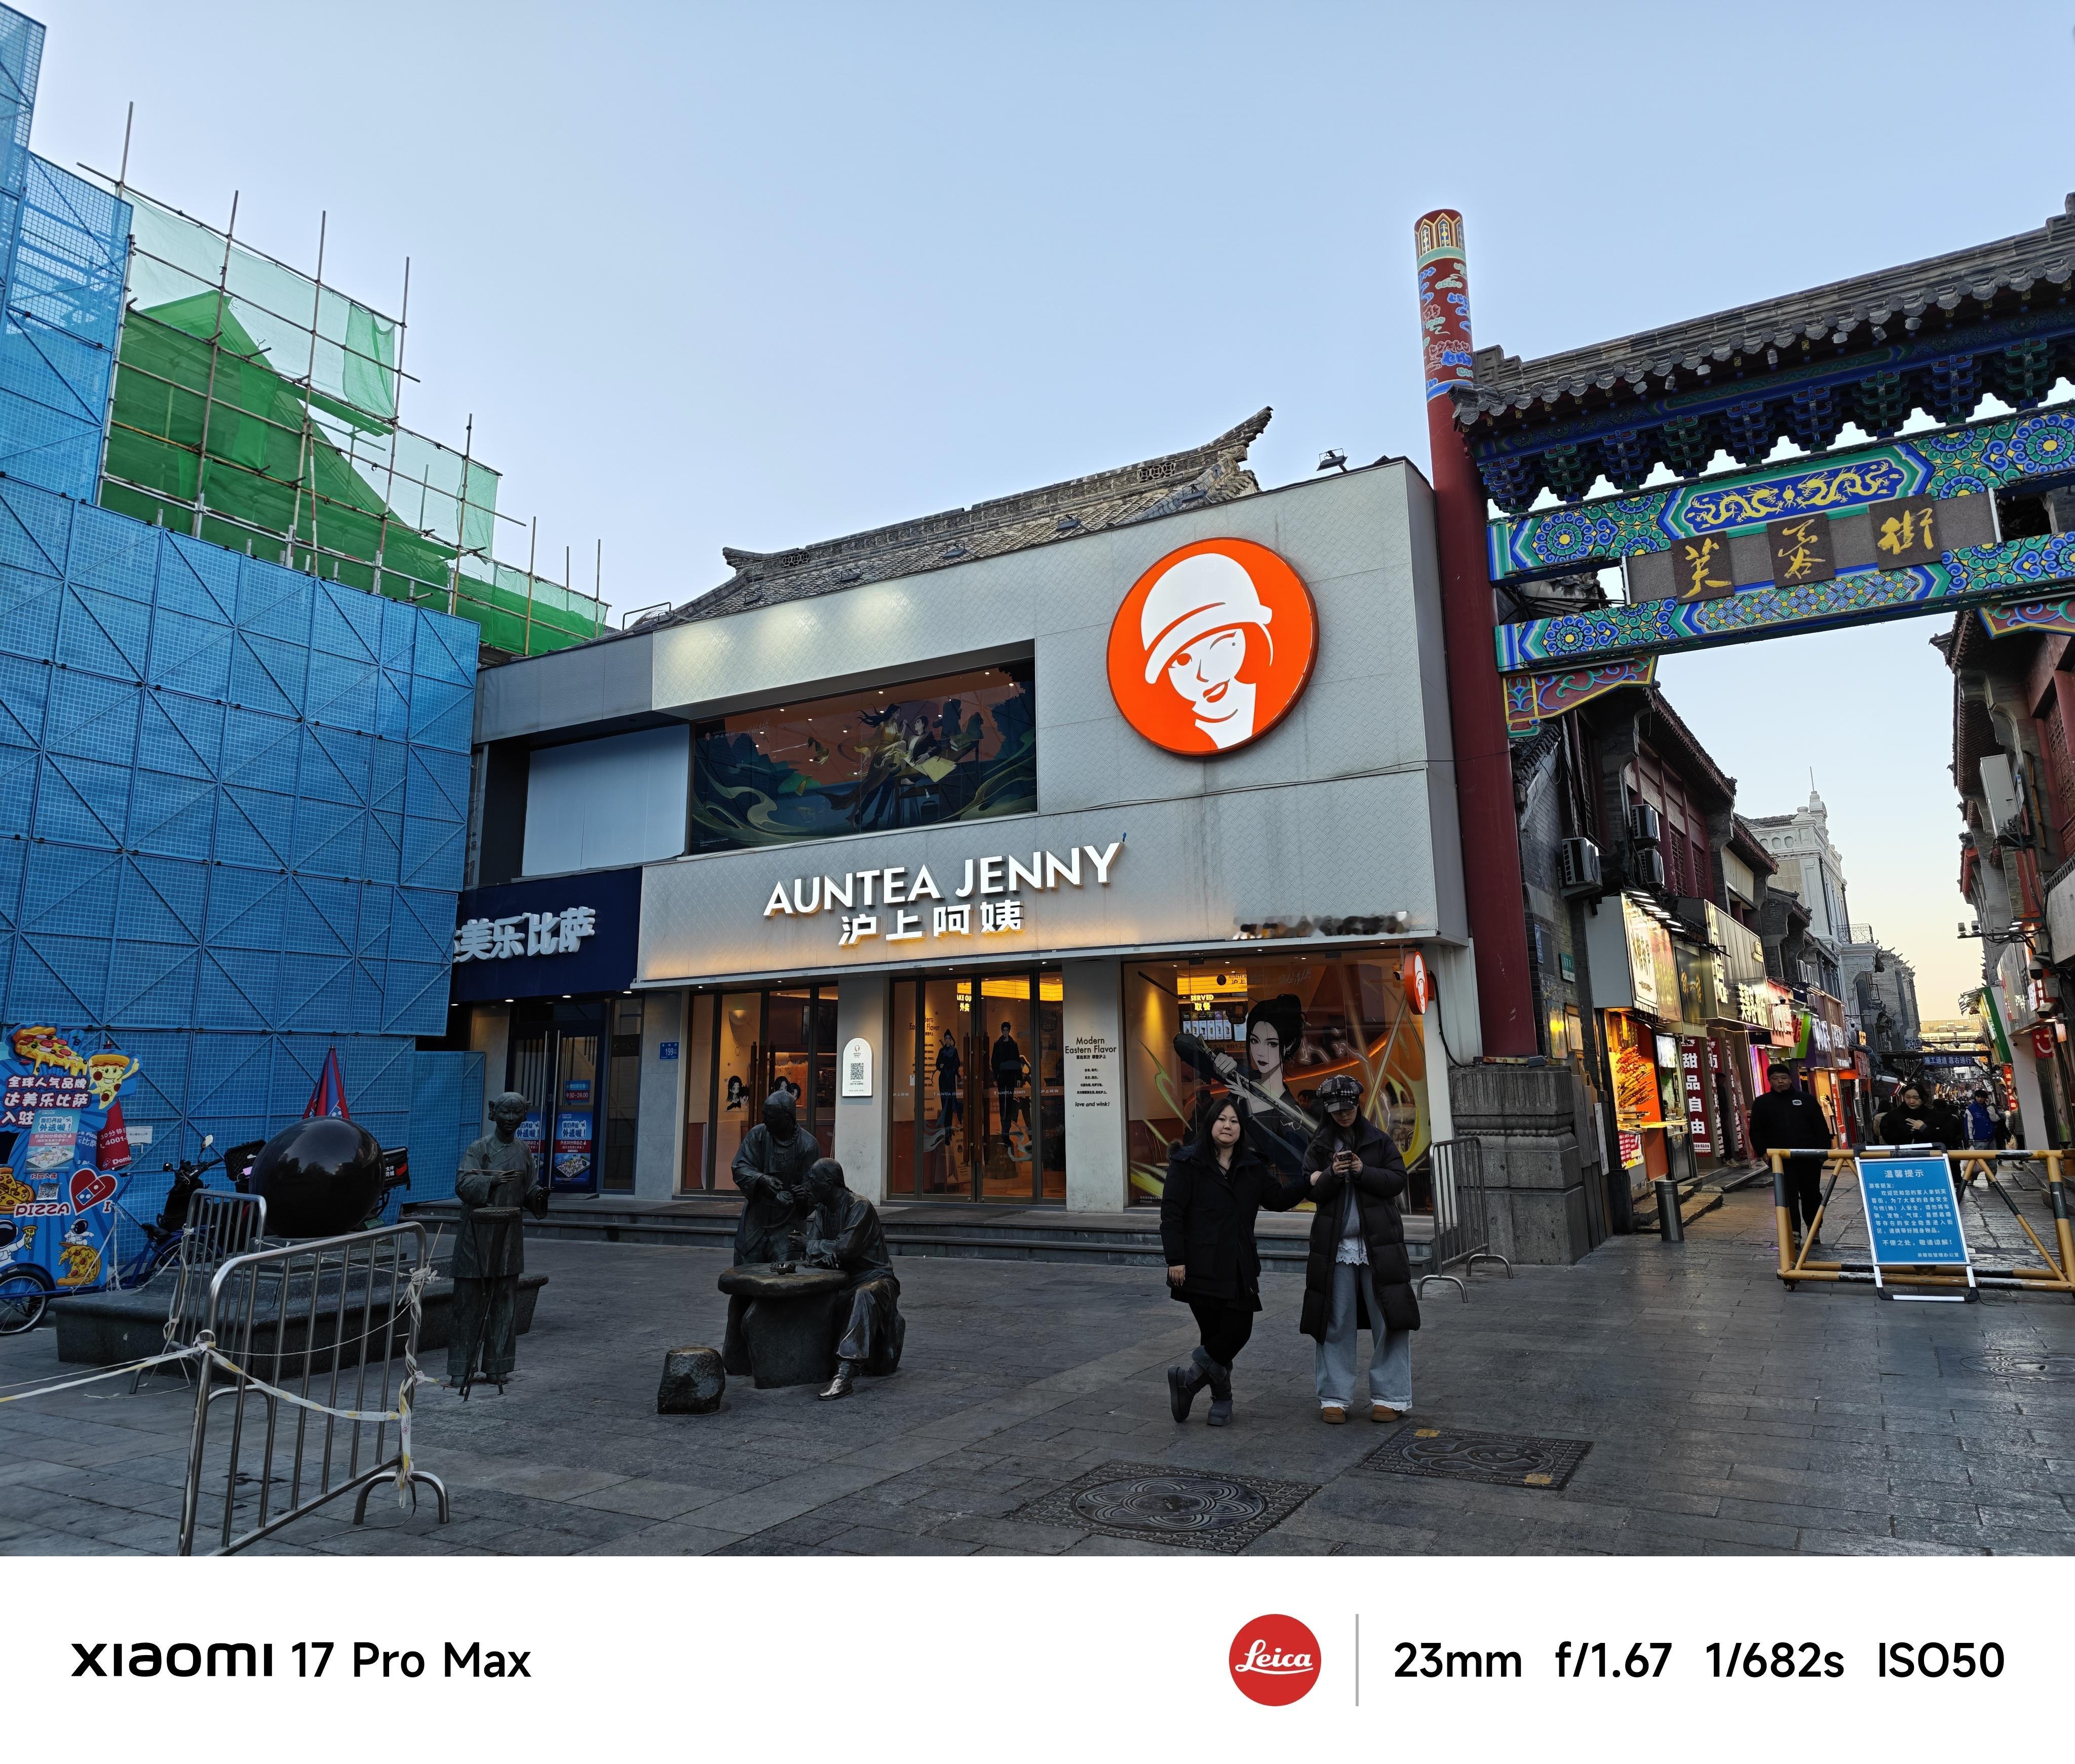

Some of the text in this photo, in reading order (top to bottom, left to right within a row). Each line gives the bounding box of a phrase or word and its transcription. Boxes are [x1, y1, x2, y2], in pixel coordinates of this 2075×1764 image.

[1681, 508, 1934, 599] 芙蓉街
[762, 842, 1124, 916] AUNTEA JENNY
[838, 899, 1024, 945] 沪上阿姨
[453, 906, 596, 963] 美乐比萨
[959, 1002, 970, 1012] 外卖
[1194, 1002, 1211, 1011] 取餐
[925, 1015, 934, 1023] dern
[1076, 1036, 1105, 1045] Modern
[665, 1048, 674, 1056] 199
[1065, 1044, 1117, 1054] Eastern Flavor
[8, 1076, 87, 1089] 全球人气品牌
[4, 1091, 89, 1107] 达美乐比萨
[1682, 1052, 1706, 1135] 甜品自由
[1, 1110, 35, 1125] 入驻
[1884, 1169, 1924, 1178] 温馨提示
[15, 1203, 70, 1217] PIZZA
